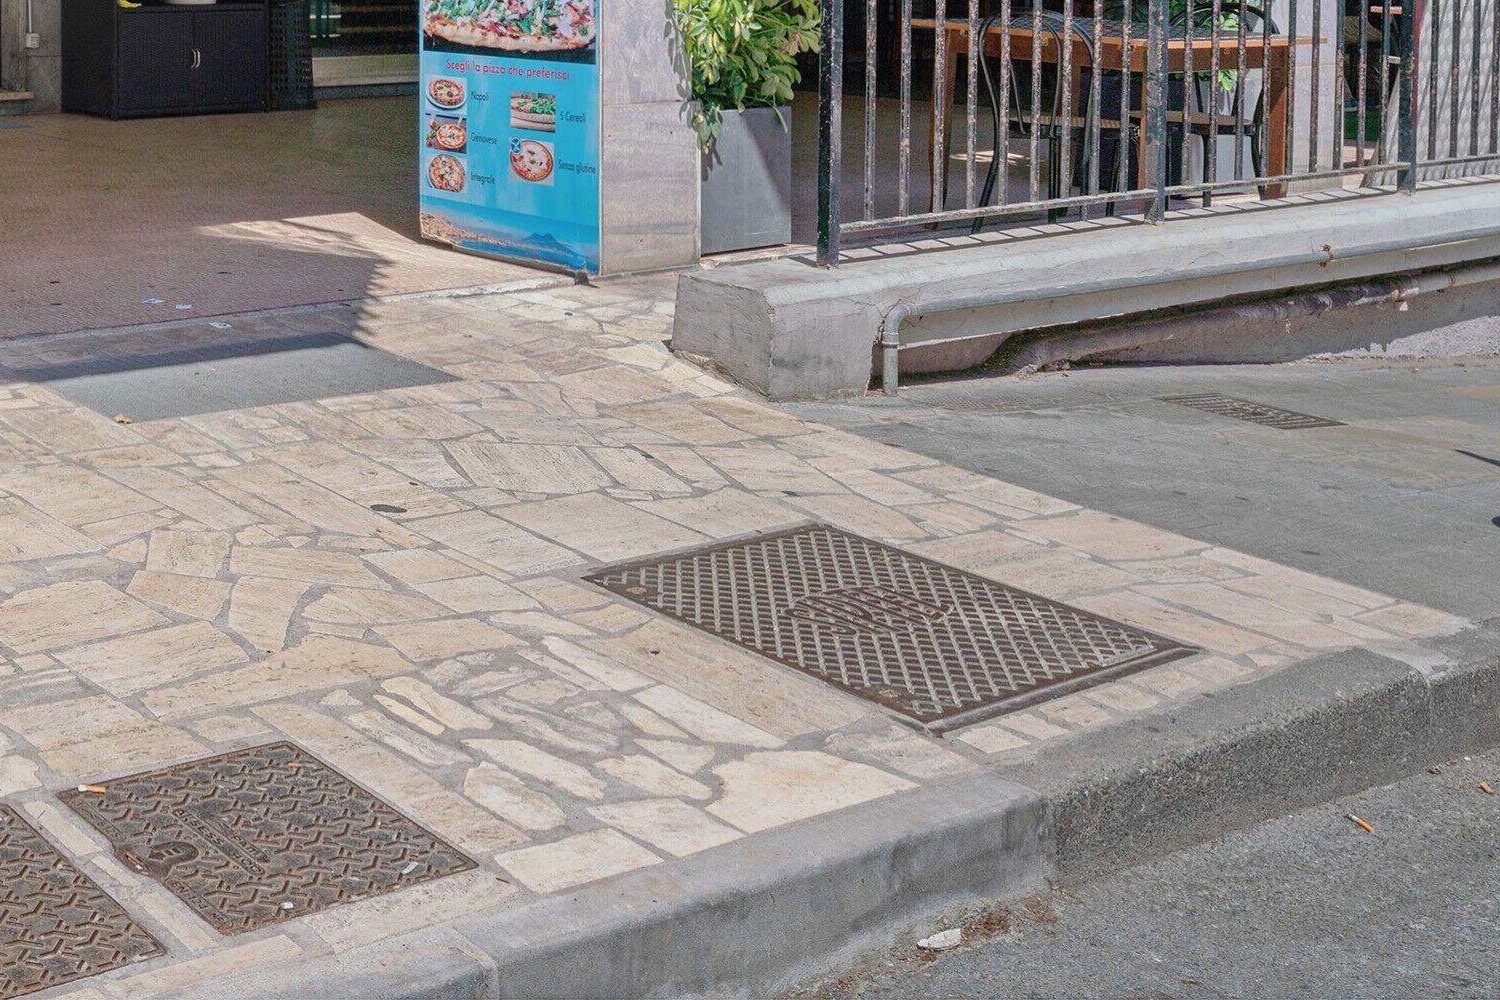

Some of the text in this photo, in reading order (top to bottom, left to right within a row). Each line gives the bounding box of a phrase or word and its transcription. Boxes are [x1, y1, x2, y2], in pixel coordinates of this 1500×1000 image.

[445, 58, 571, 81] Scegli la pizza che preferisci
[470, 91, 490, 103] Napoli
[470, 132, 498, 146] Genovese
[558, 160, 574, 173] Senza
[470, 171, 496, 186] Integrale
[172, 807, 224, 846] AKSESS
